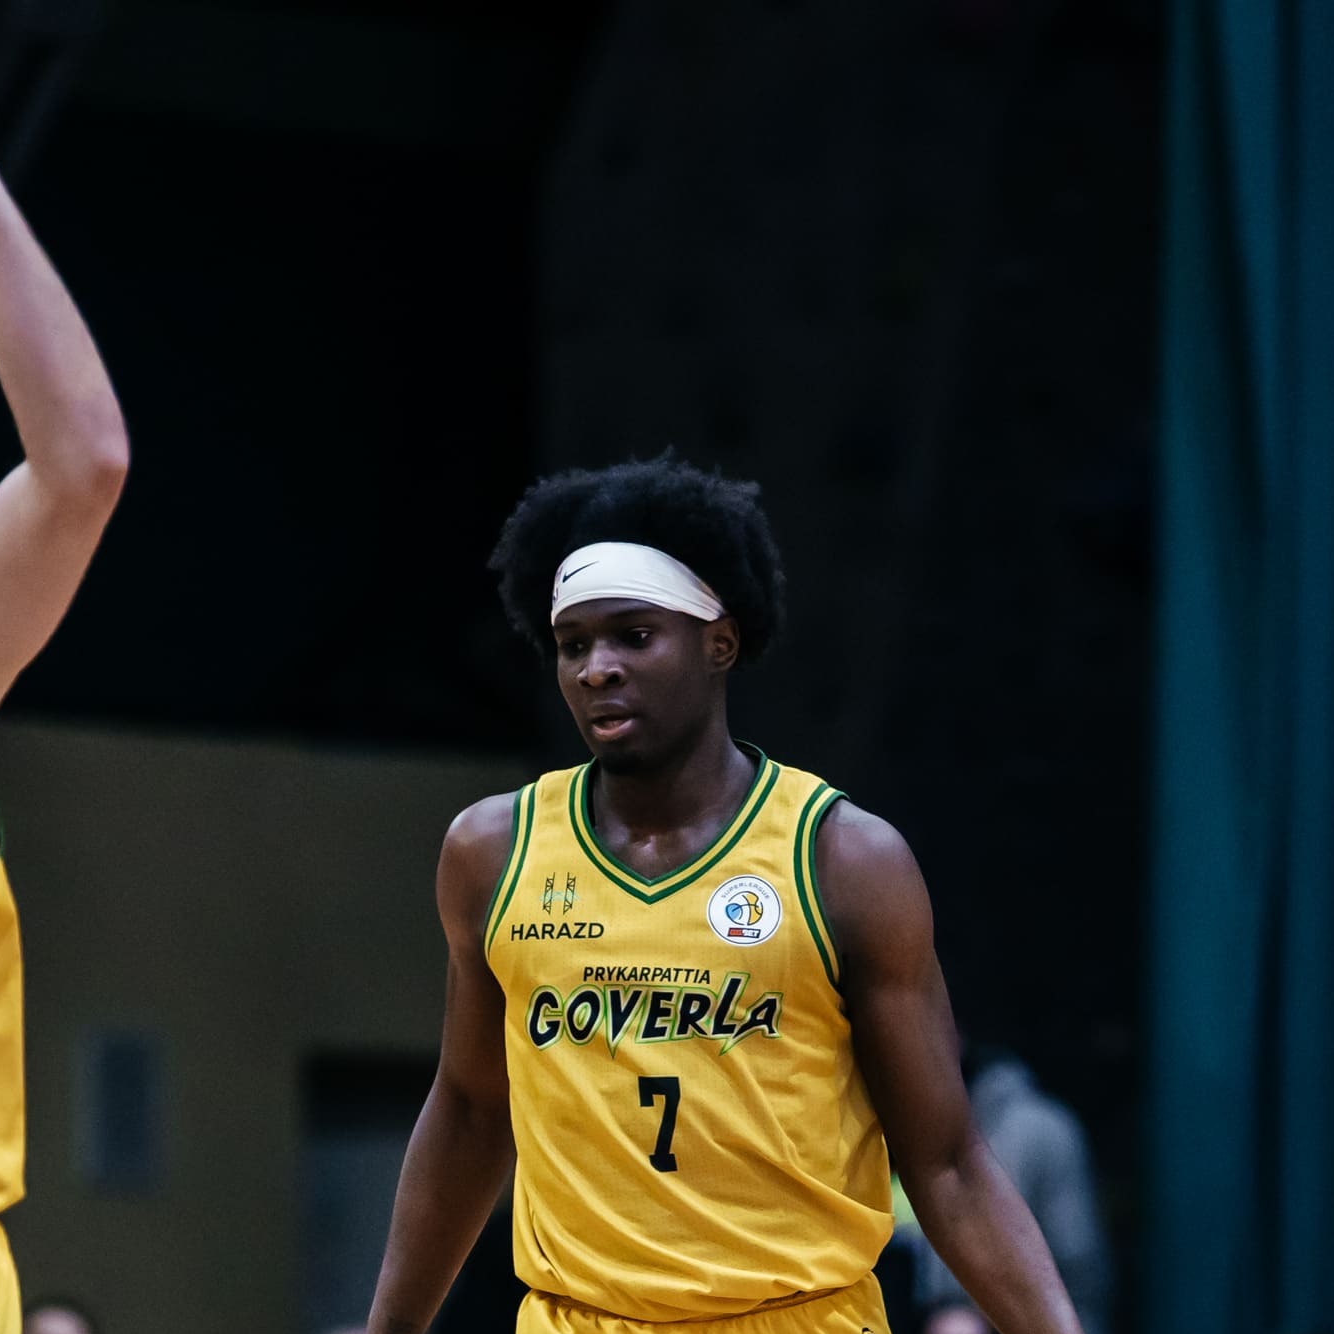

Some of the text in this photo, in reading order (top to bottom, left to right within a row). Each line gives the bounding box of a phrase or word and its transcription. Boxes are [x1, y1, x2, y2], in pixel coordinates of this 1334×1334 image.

[510, 921, 605, 942] HARAZD
[582, 965, 712, 985] PRYKARPATTIA
[526, 974, 782, 1051] GOVERLA
[637, 1075, 682, 1174] 7
